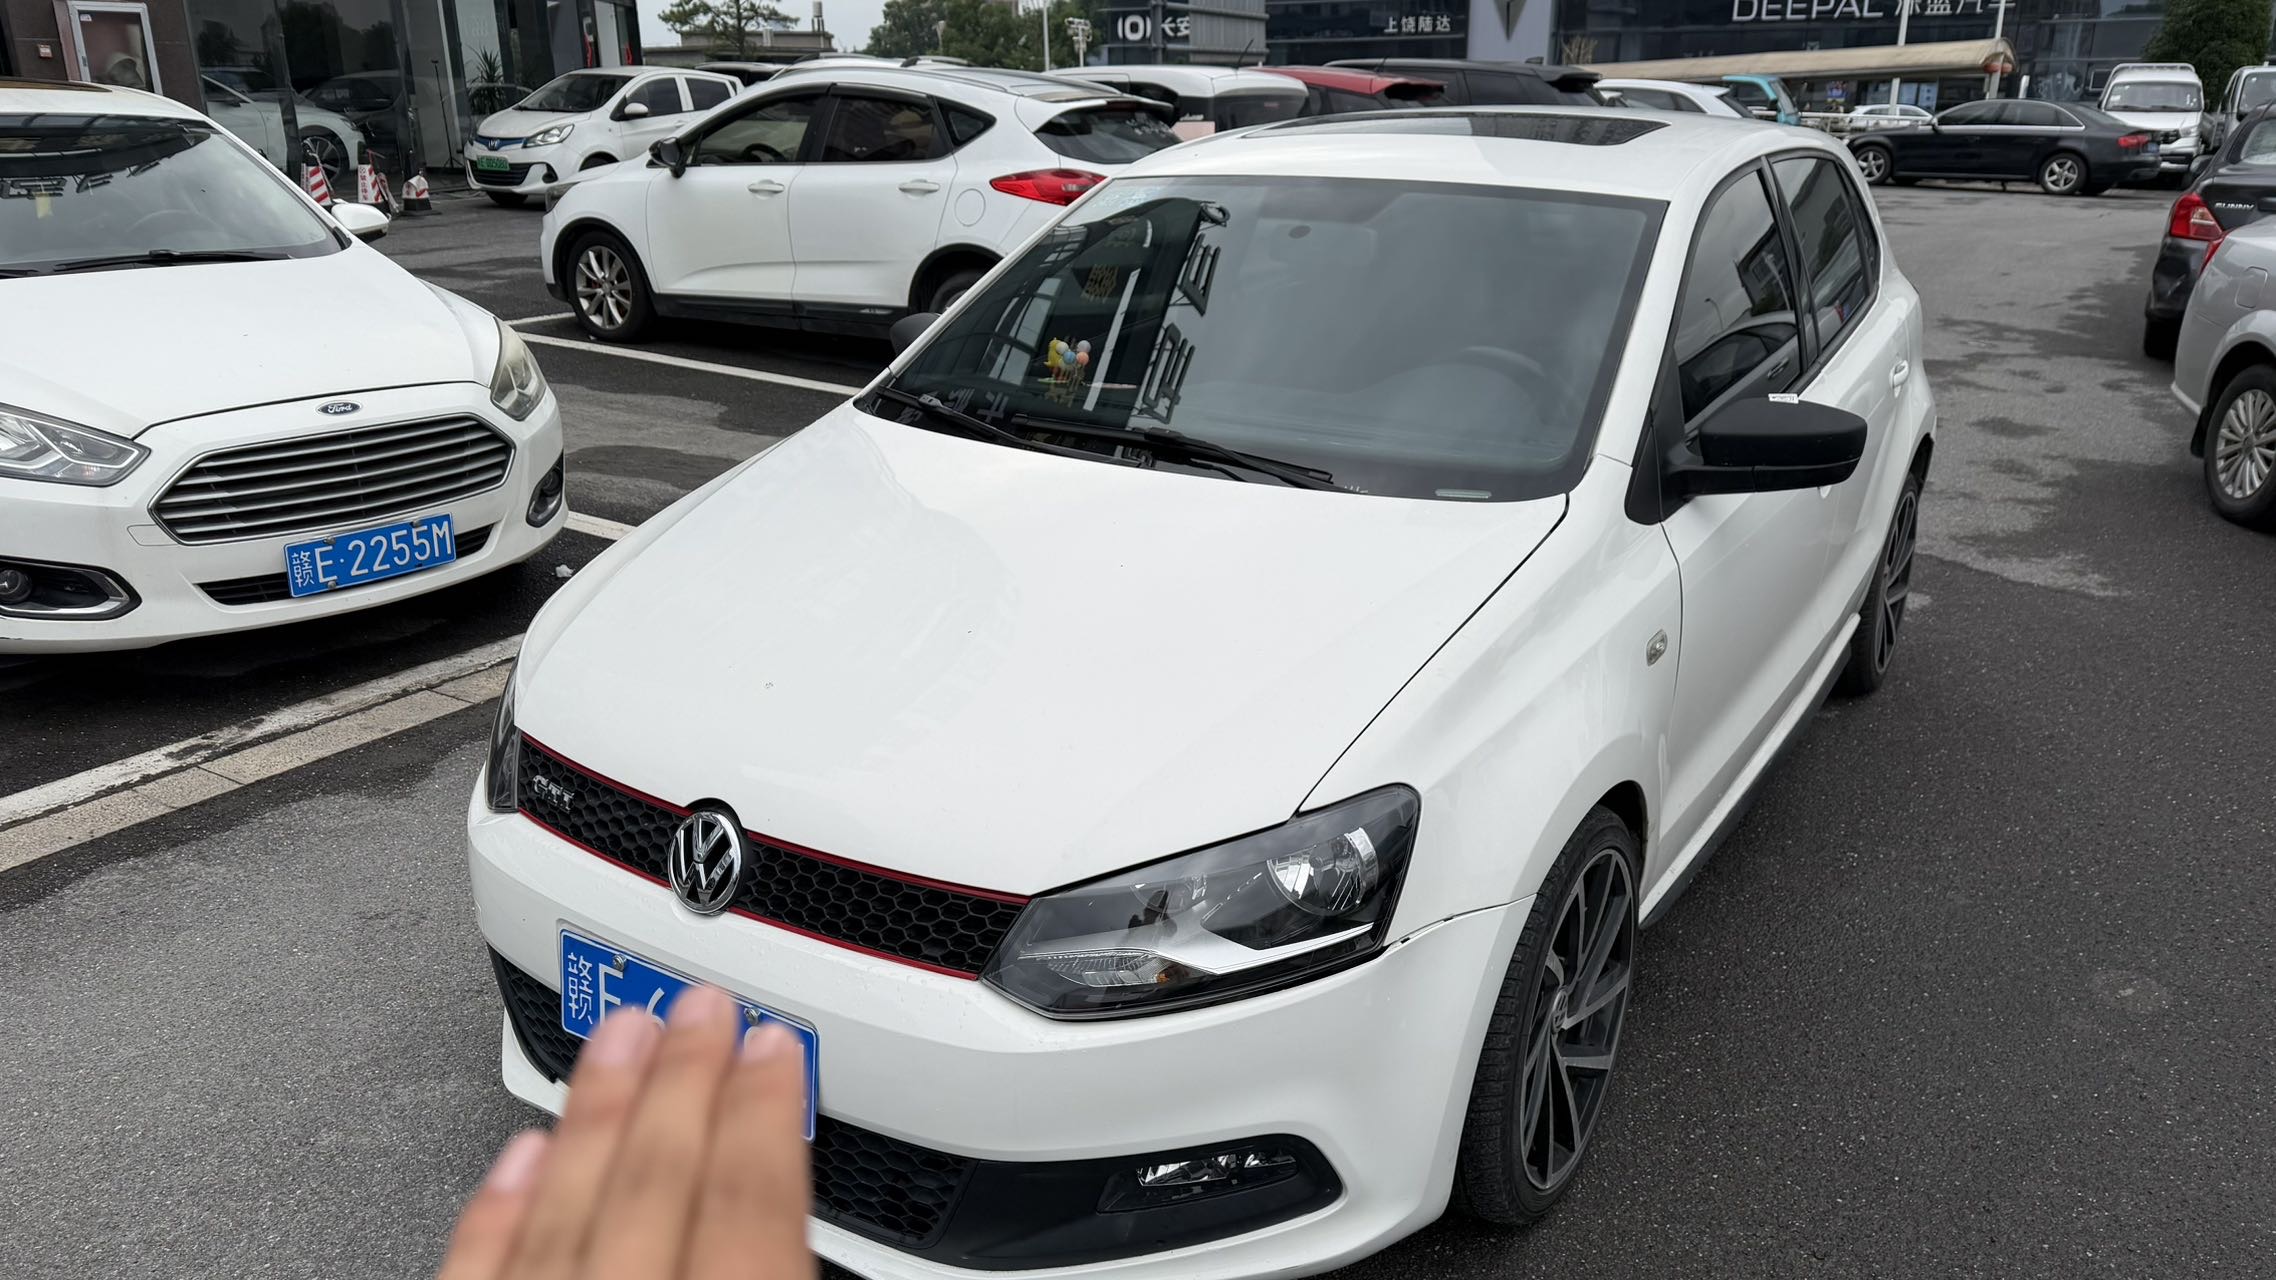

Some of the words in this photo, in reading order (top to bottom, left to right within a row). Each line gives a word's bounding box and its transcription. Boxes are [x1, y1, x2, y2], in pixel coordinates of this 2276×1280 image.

[1732, 0, 1884, 22] DEEPAL
[1384, 14, 1451, 33] 上饶陆达
[327, 402, 353, 413] Ford
[533, 775, 575, 811] GTI
